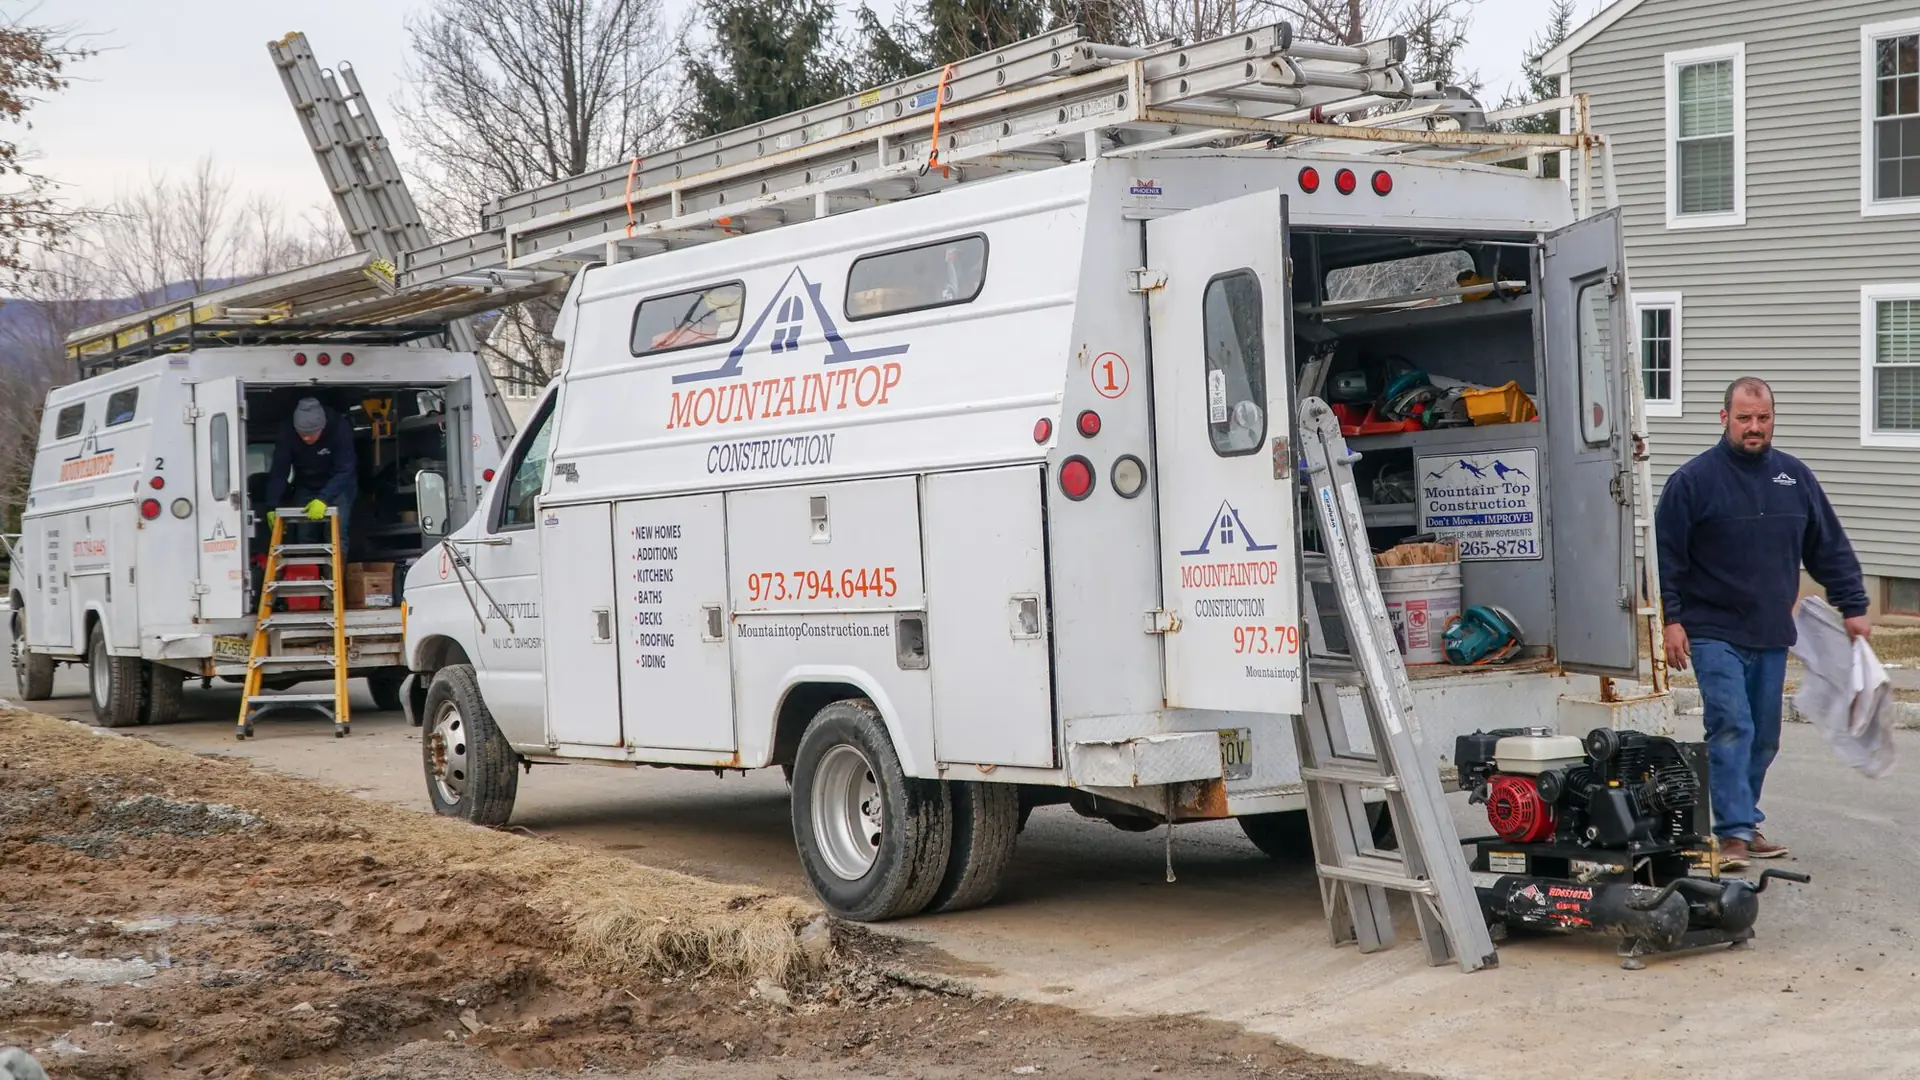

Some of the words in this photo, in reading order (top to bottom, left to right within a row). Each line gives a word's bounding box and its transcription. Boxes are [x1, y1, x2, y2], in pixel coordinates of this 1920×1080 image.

[1102, 360, 1119, 391] 1
[666, 362, 902, 430] MOUNTAINTOP
[706, 433, 836, 475] CONSTRUCTION
[154, 456, 165, 471] 2
[1424, 484, 1496, 499] Mountain
[1502, 482, 1531, 496] Top
[1429, 498, 1527, 513] Construction
[1427, 516, 1450, 527] Don't
[635, 526, 653, 540] NEW
[654, 525, 682, 539] HOMES
[1466, 530, 1483, 539] HOME
[1484, 528, 1533, 539] IMPROVEMENTS
[637, 546, 678, 561] ADDITIONS
[1460, 540, 1537, 556] 265-8781
[637, 569, 674, 582] KITCHENS
[1181, 560, 1278, 588] MOUNTAINTOP
[748, 566, 898, 602] 973.794.6445
[638, 590, 663, 604] BATHS
[1195, 598, 1265, 617] CONSTRUCTION
[639, 612, 663, 626] DECKS
[737, 622, 891, 641] MountaintopConstruction.net
[640, 633, 675, 648] ROOFING
[641, 655, 666, 669] SIDING
